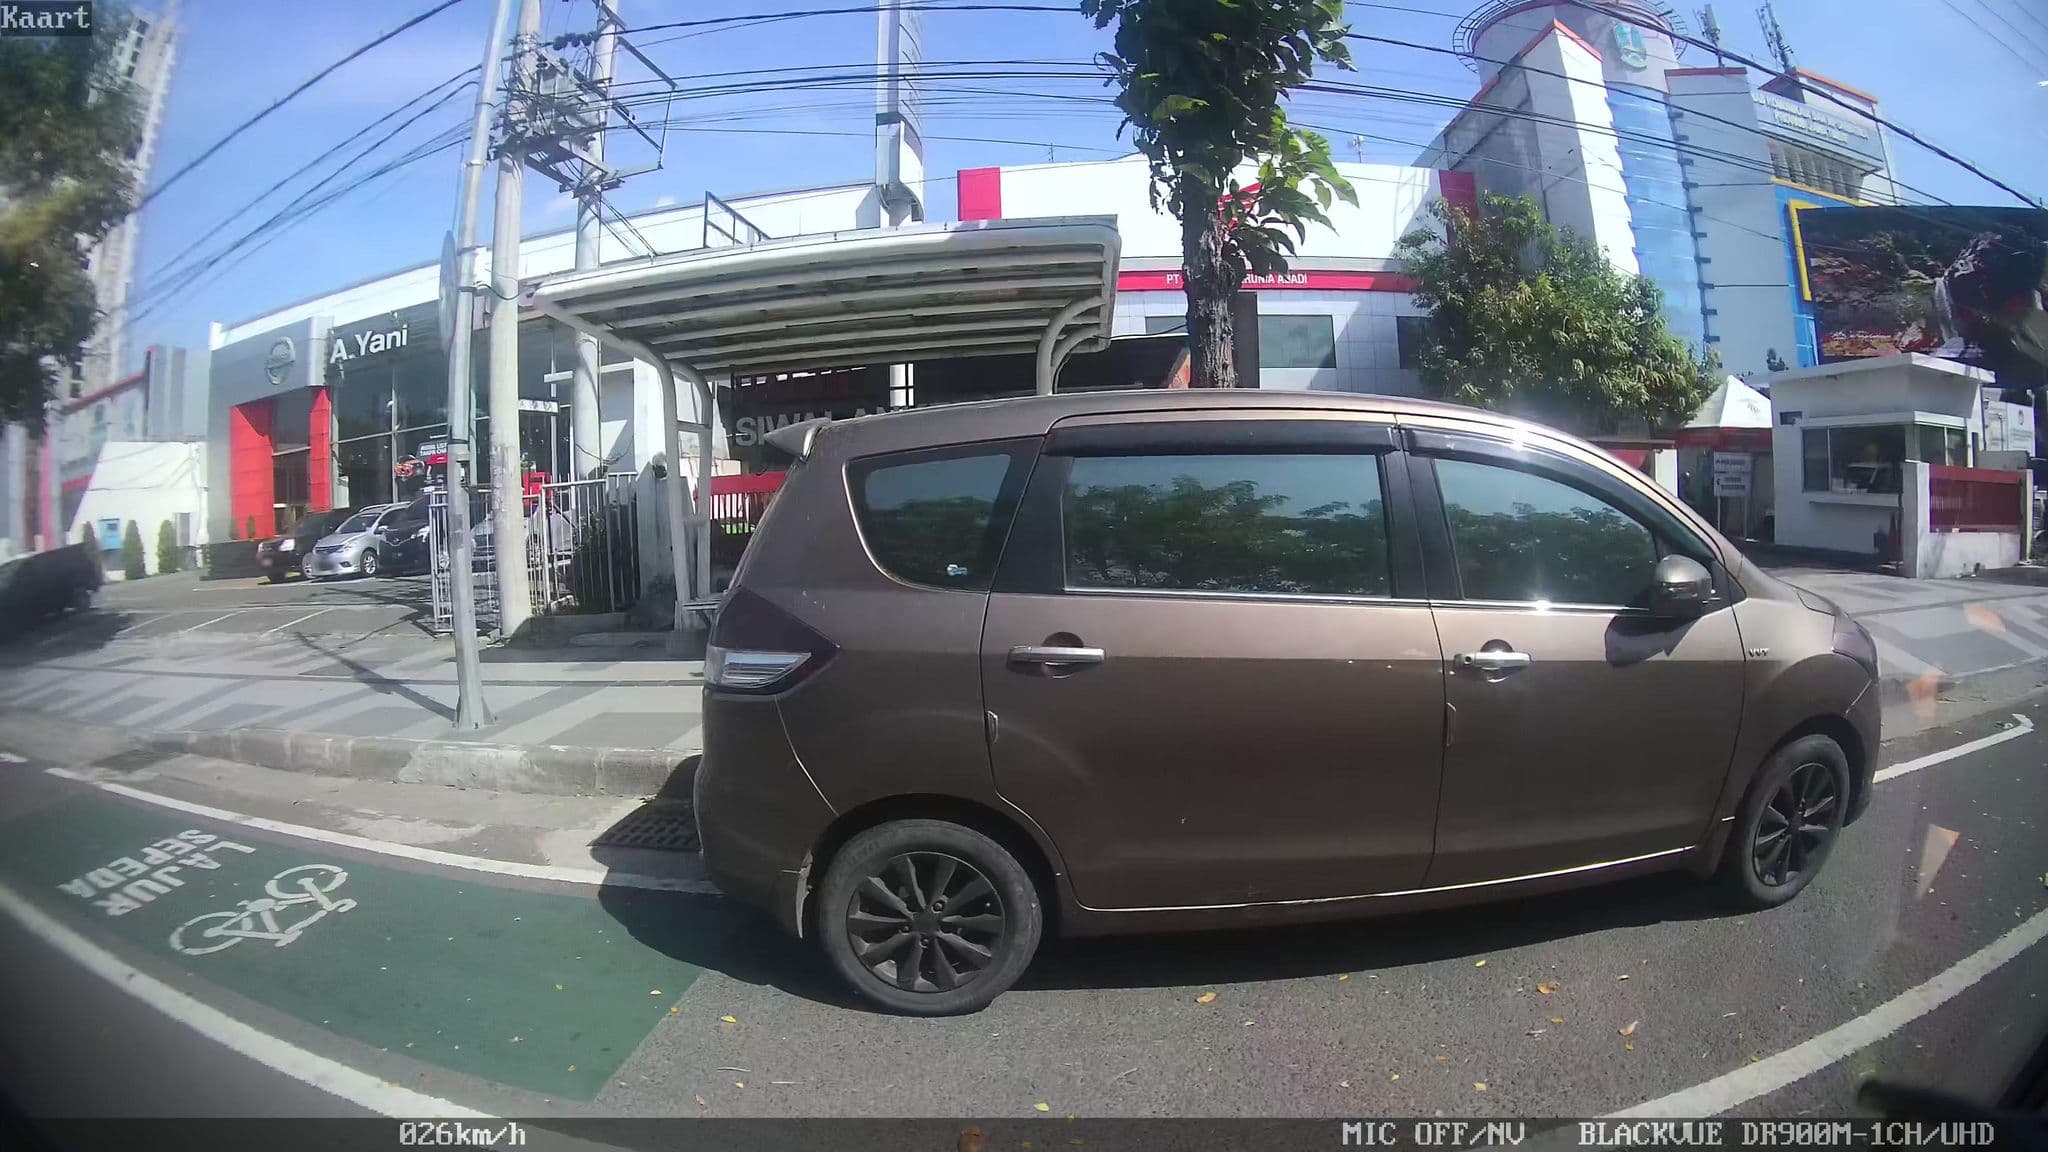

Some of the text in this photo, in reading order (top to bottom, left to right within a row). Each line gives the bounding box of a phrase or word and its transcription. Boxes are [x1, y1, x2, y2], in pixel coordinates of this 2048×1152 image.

[1166, 273, 1180, 284] PT
[1241, 273, 1275, 284] RUNIA
[56, 829, 218, 898] SEPEDA
[93, 840, 257, 916] LAJUR
